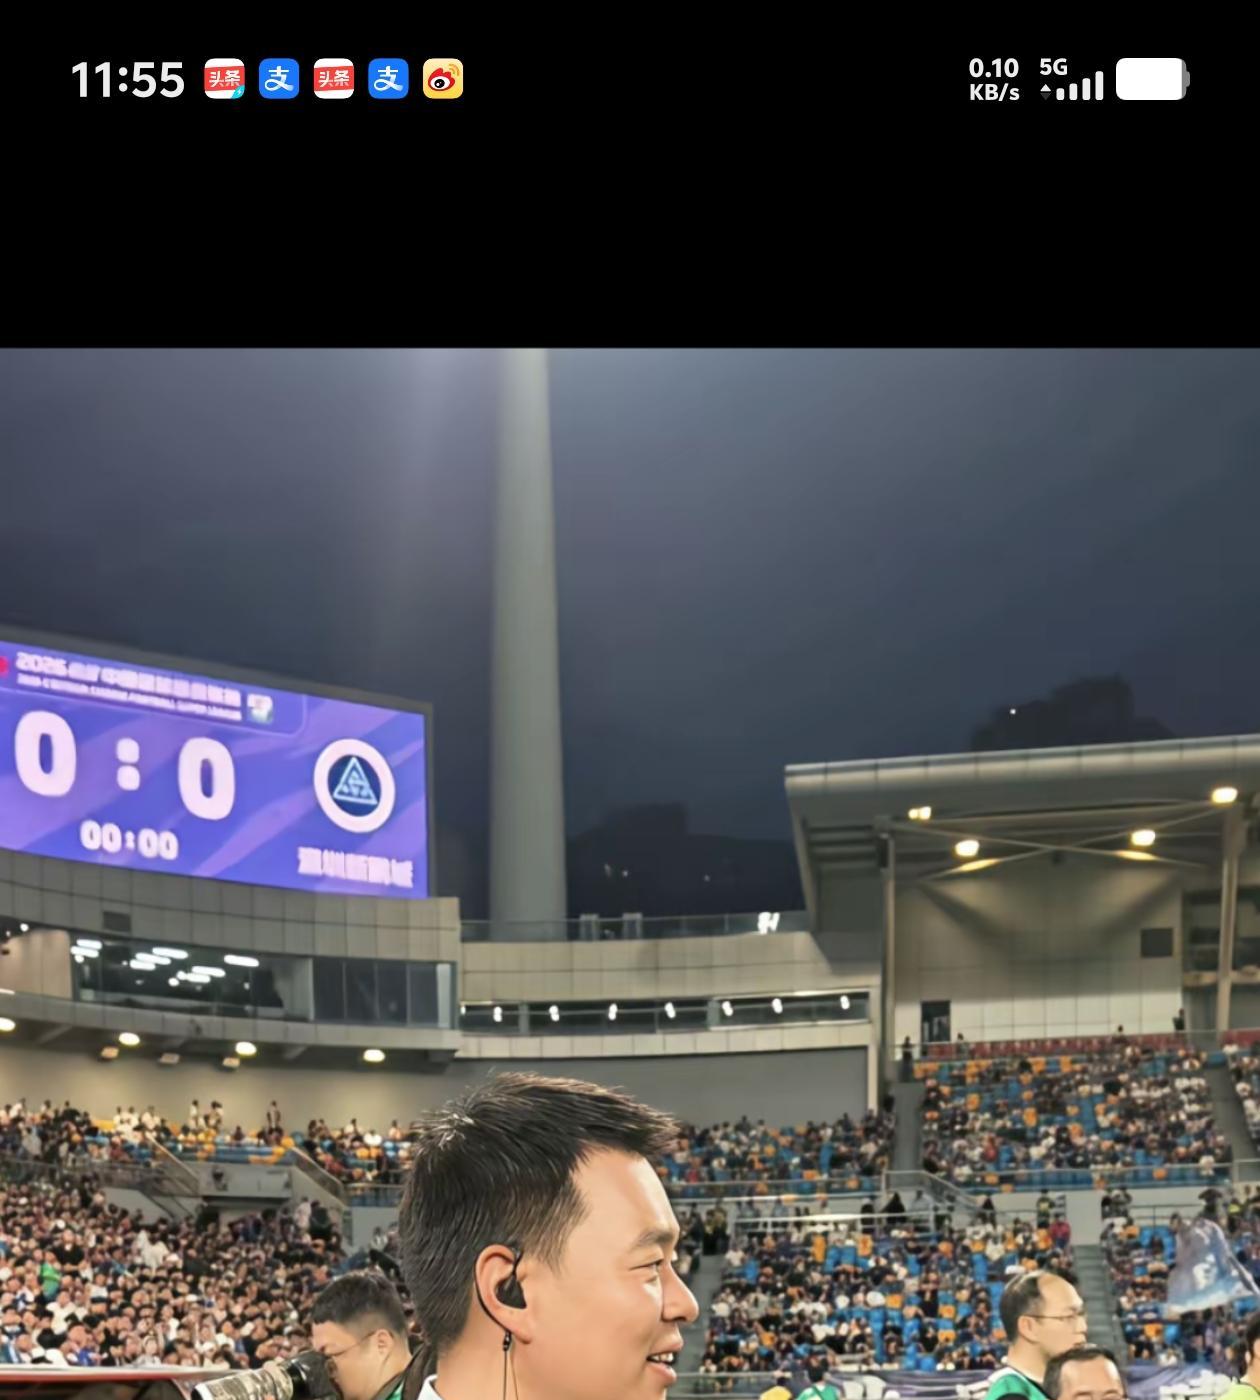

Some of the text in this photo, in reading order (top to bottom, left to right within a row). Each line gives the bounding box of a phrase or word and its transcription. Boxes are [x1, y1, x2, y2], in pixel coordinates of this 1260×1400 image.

[14, 710, 76, 796] 0
[178, 736, 236, 820] 0
[80, 819, 179, 860] 00:00
